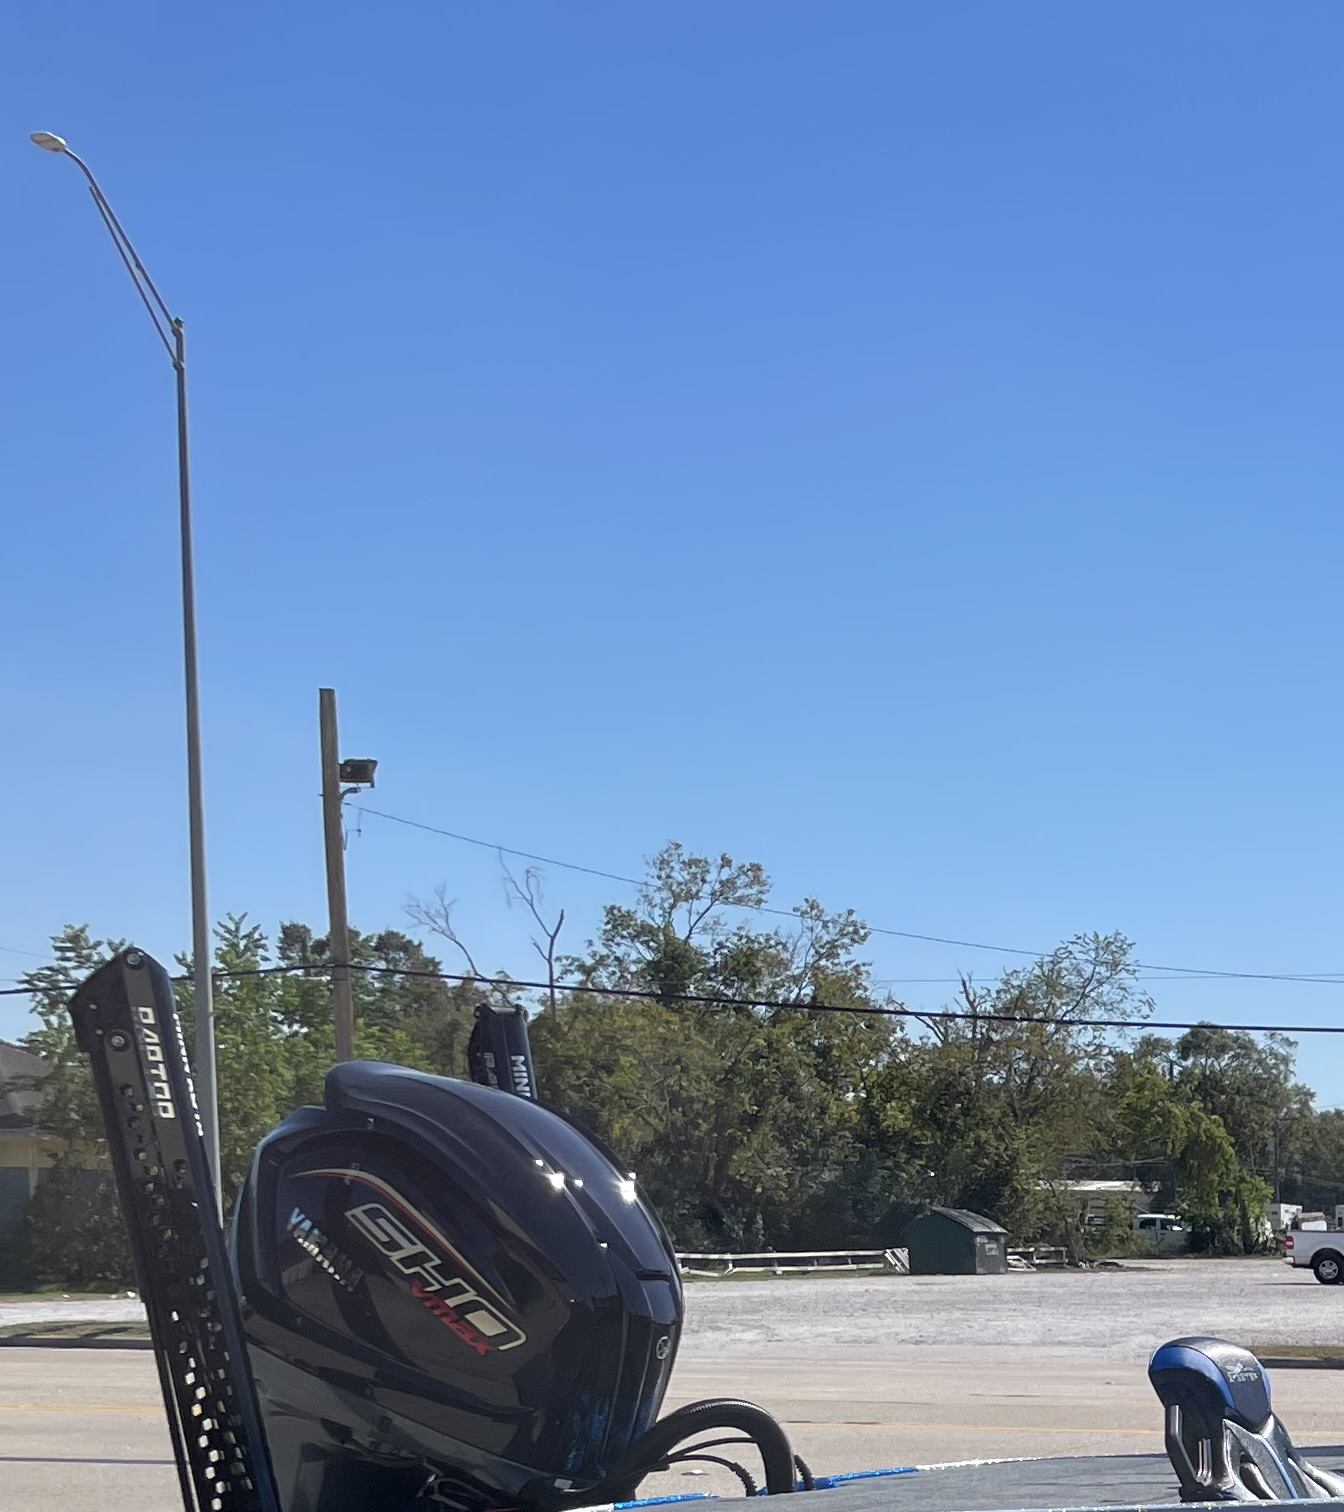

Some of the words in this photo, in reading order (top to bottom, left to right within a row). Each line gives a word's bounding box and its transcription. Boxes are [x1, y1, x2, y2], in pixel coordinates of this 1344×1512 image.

[131, 1006, 175, 1119] RAPTOR
[287, 1207, 363, 1292] YAMAHA
[344, 1203, 527, 1350] SHO
